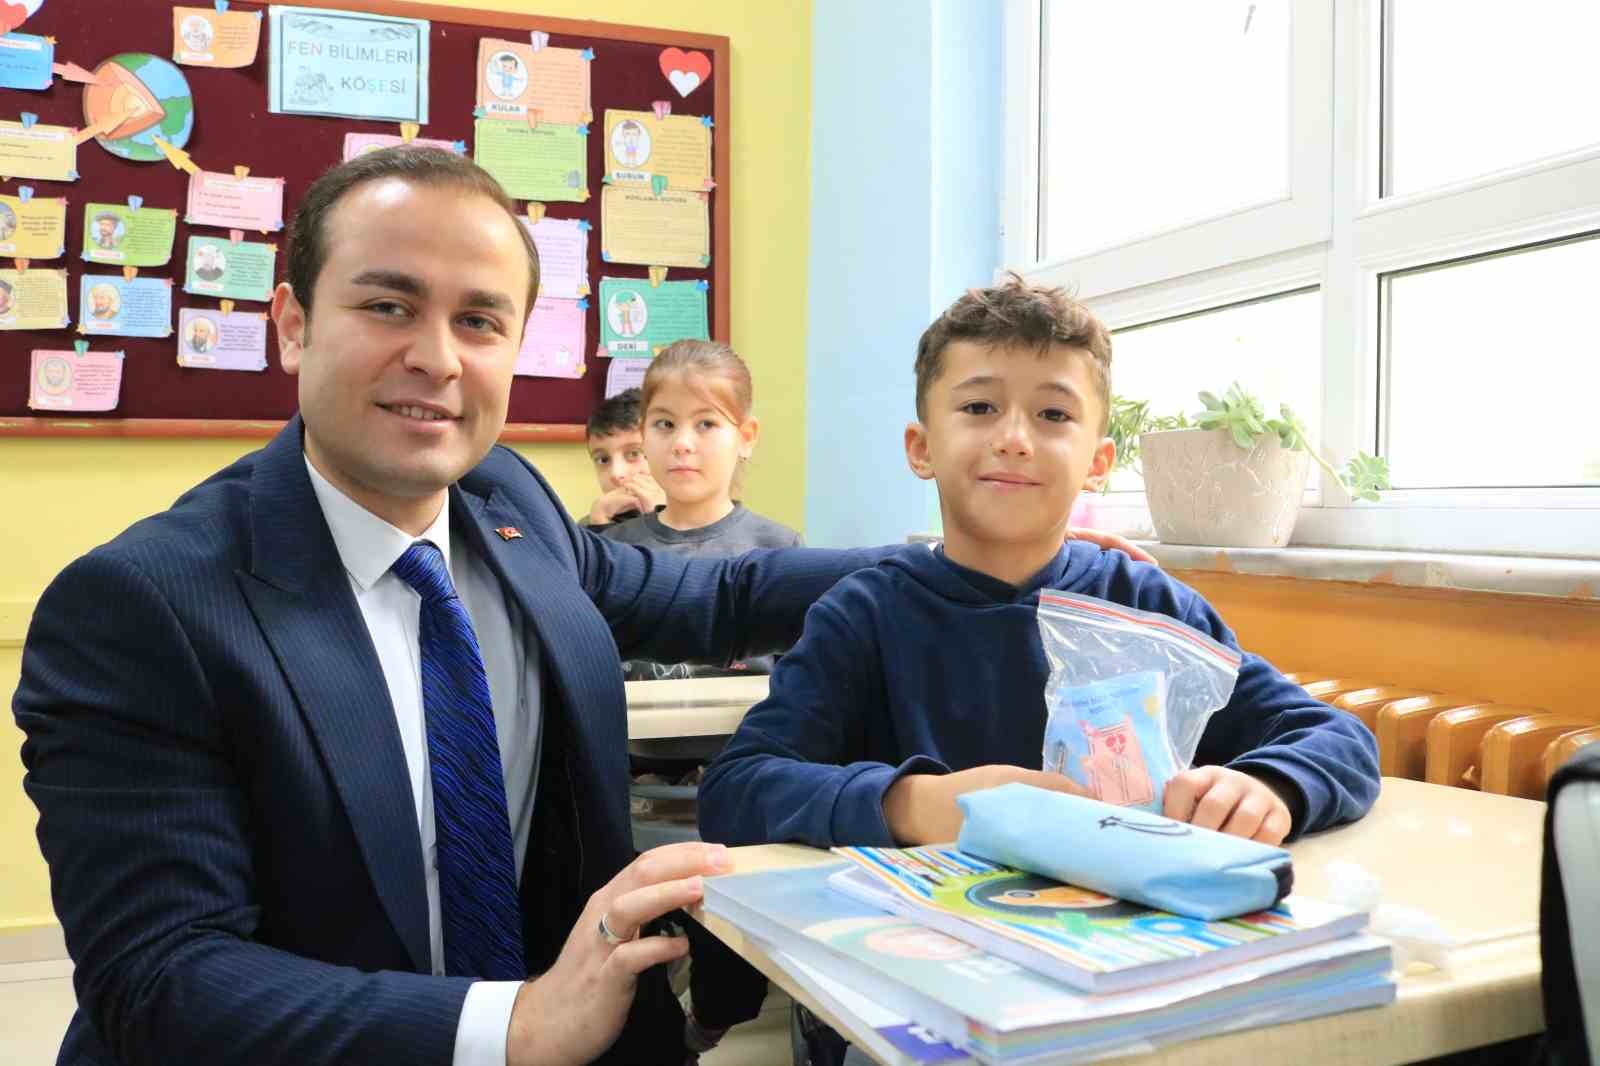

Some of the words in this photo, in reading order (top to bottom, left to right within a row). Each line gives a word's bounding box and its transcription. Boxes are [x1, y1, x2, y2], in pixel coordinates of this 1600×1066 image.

[288, 40, 322, 56] FEN
[328, 43, 414, 65] BİLİMLERİ
[341, 75, 407, 95] KÖŞESİ
